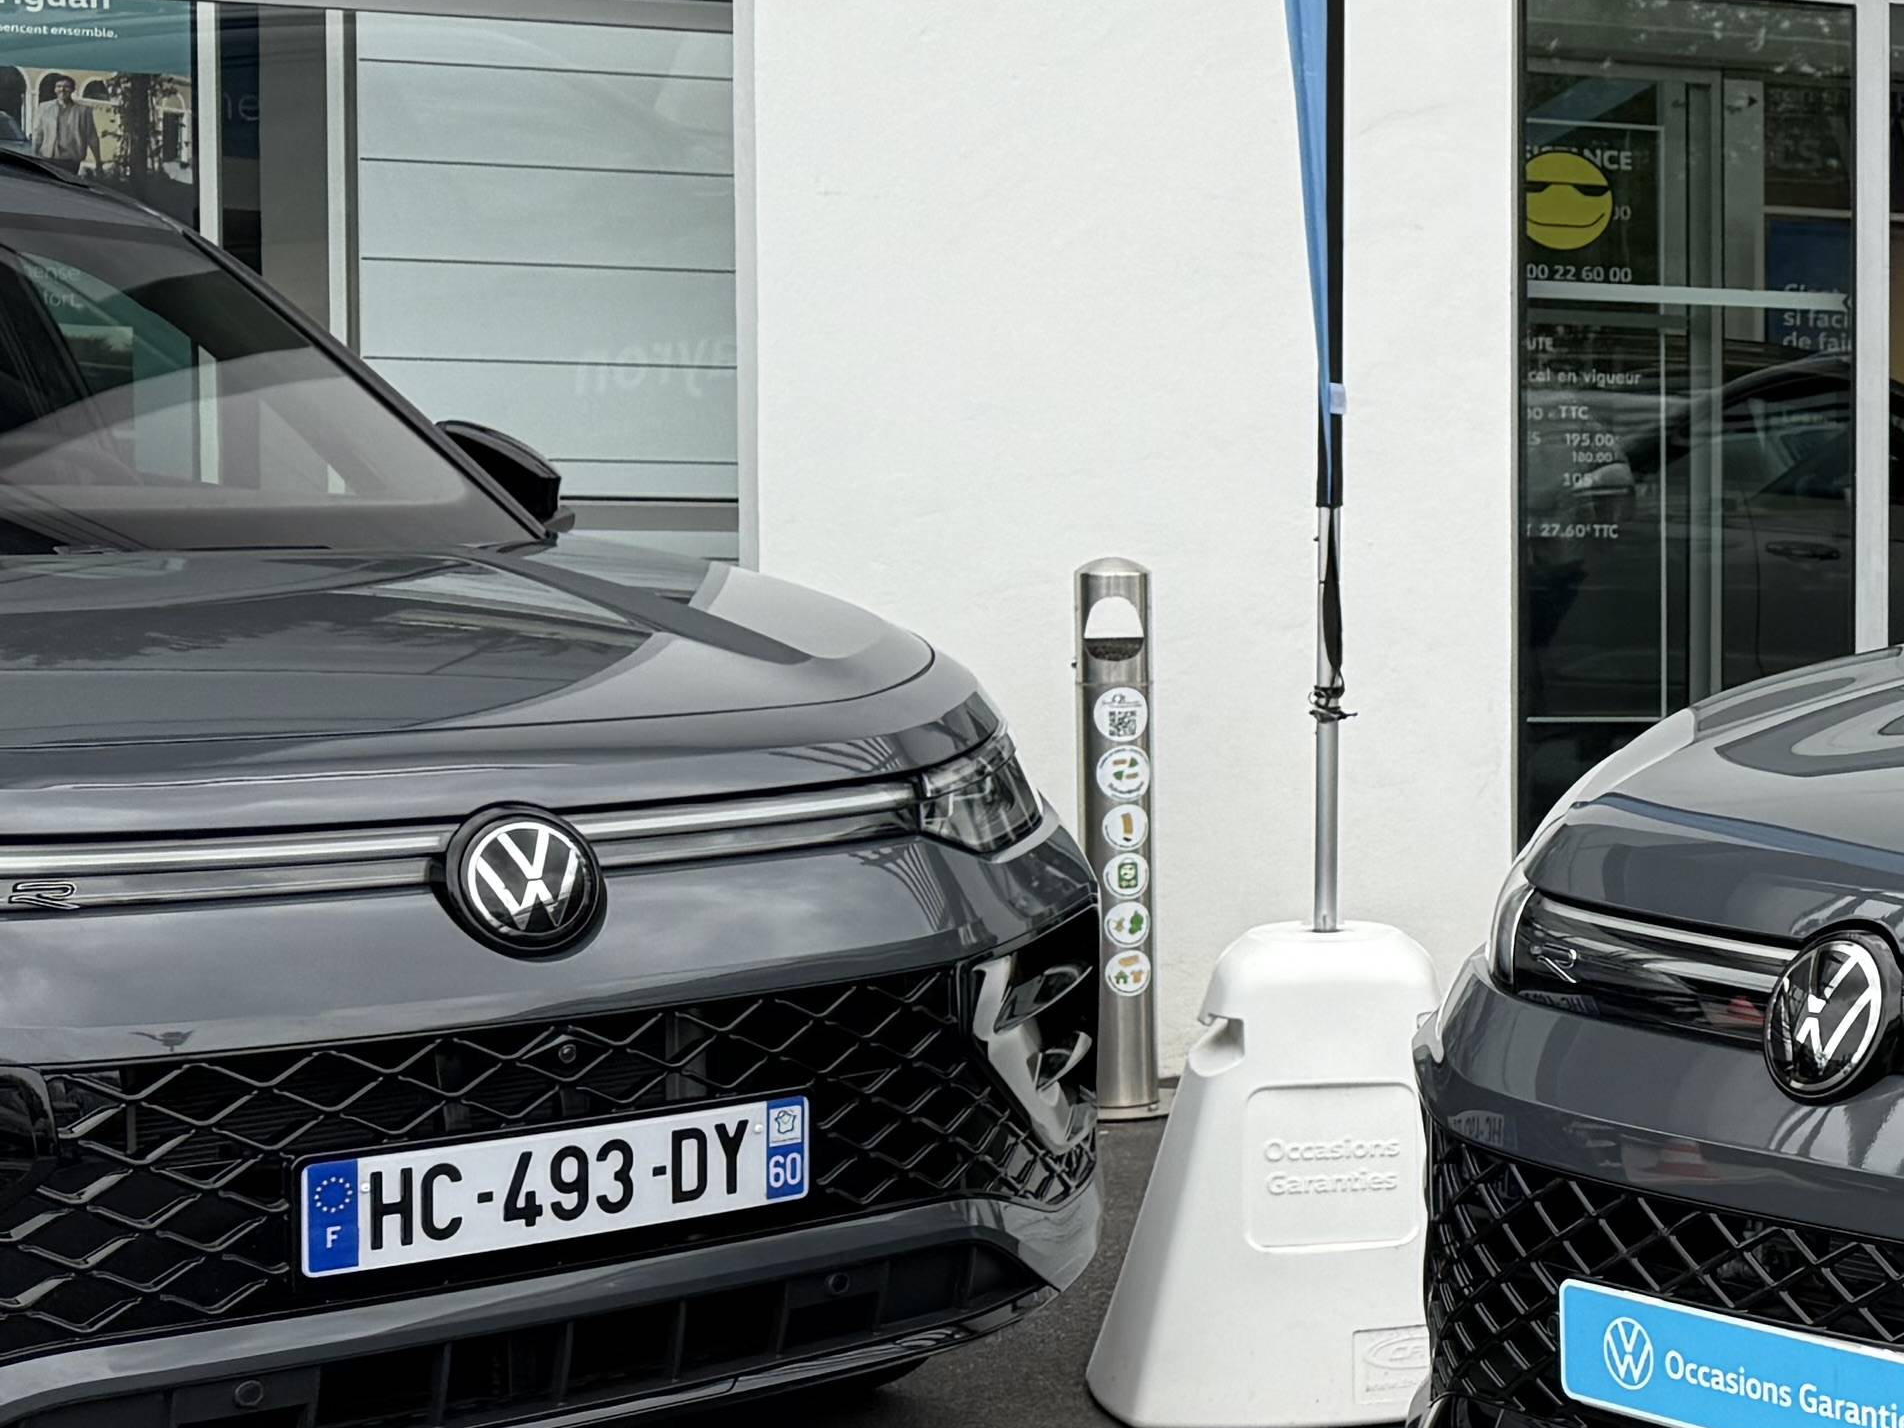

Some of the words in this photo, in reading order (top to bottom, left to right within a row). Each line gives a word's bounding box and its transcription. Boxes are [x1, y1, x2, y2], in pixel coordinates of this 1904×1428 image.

[0, 23, 48, 35] encent
[51, 24, 118, 39] ensemble.
[1555, 265, 1576, 281] 22
[1582, 266, 1604, 282] 60
[1609, 267, 1632, 283] 00
[1558, 371, 1577, 384] en
[1583, 368, 1642, 388] vigueur
[1559, 405, 1589, 421] TTC
[1264, 1138, 1400, 1163] Occasions
[324, 1225, 342, 1250] F
[369, 1118, 749, 1251] HC-493-DY
[768, 1151, 802, 1187] 60
[1267, 1170, 1399, 1197] Garanties
[1603, 1316, 1654, 1391] VW
[1664, 1349, 1792, 1408] Occasions
